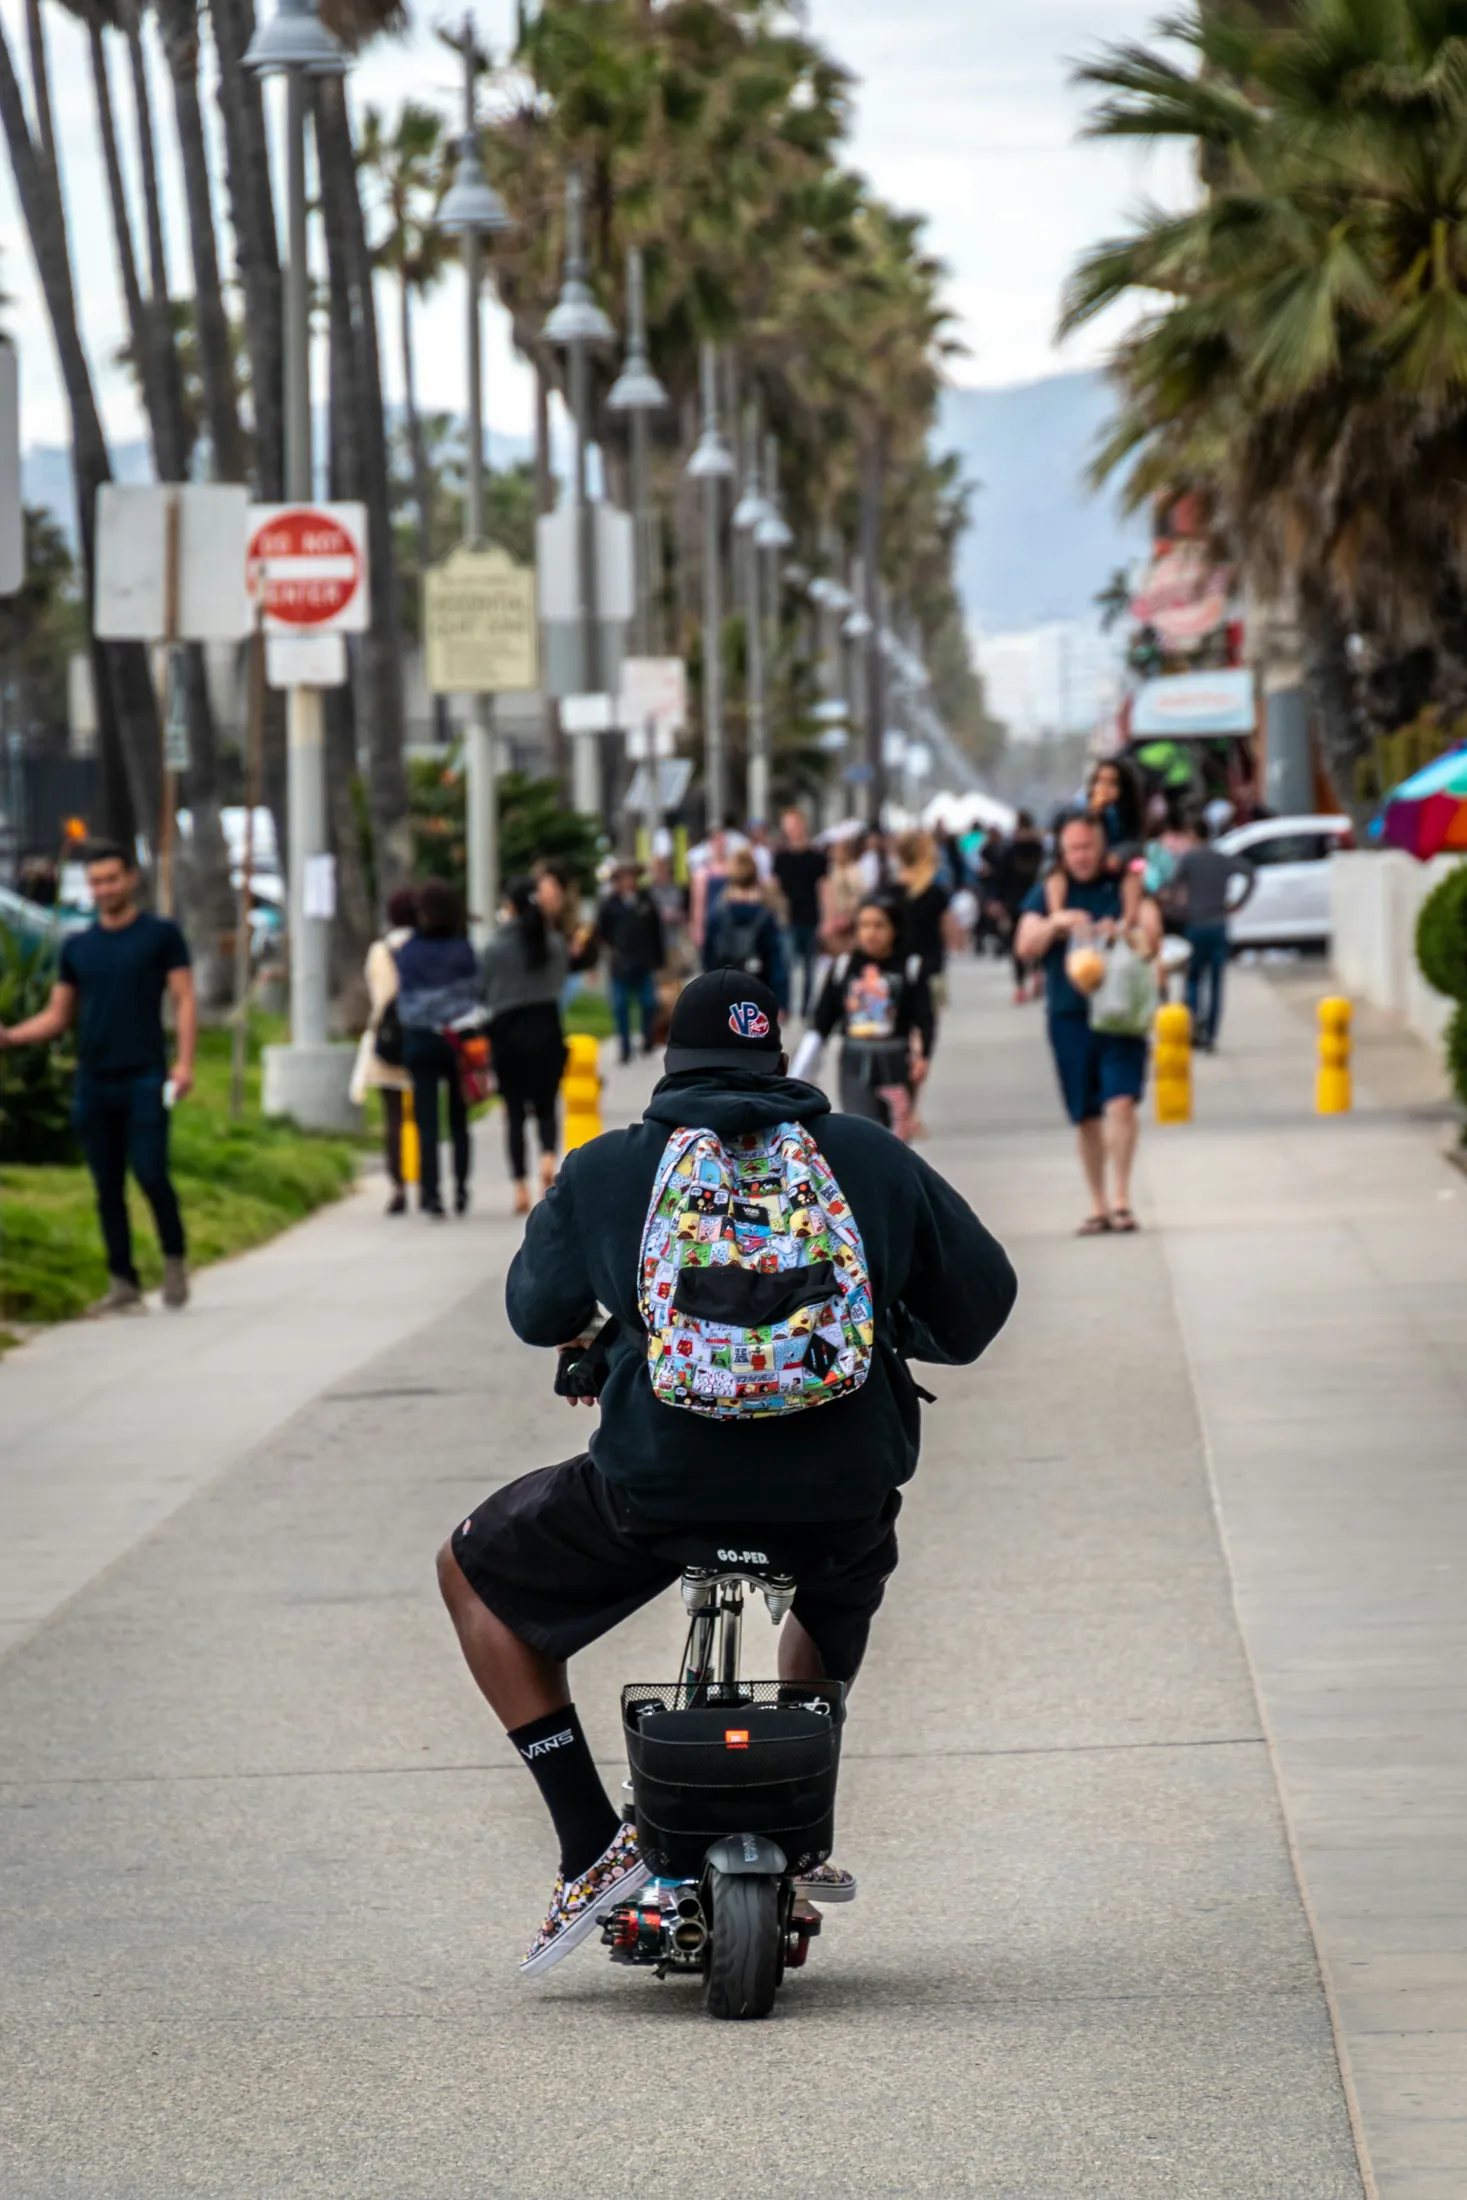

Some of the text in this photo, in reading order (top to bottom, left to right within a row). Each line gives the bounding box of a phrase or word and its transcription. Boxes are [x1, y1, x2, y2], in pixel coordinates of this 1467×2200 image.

[260, 530, 344, 554] DO NOT
[265, 582, 341, 606] ENTER
[729, 1001, 759, 1036] VP
[742, 1206, 760, 1215] VANS
[717, 1548, 767, 1565] GO-PED
[520, 1729, 574, 1759] VANS
